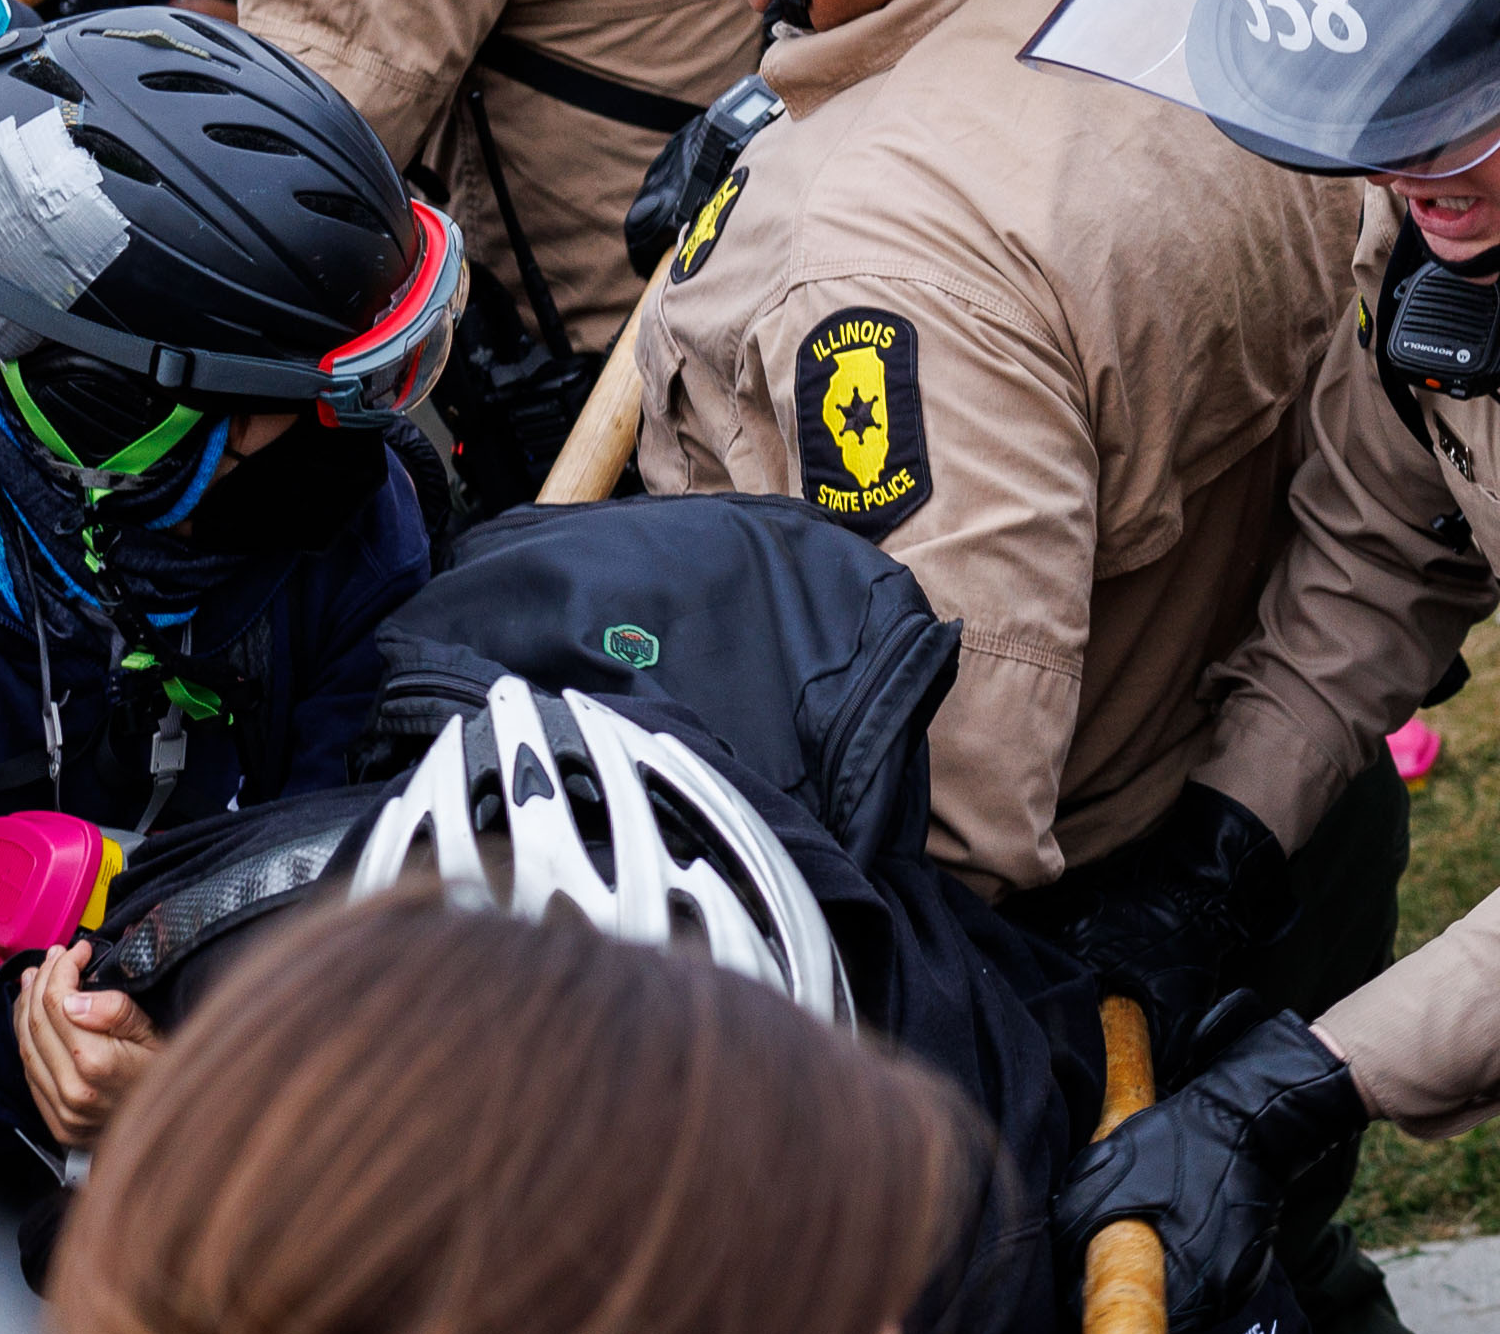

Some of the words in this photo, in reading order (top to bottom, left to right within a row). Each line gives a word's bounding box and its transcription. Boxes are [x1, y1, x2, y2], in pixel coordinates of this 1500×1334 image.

[813, 320, 896, 361] ILLINOIS
[1402, 340, 1454, 357] MOTOROLA
[817, 483, 859, 513] STATE
[861, 468, 915, 511] POLICE
